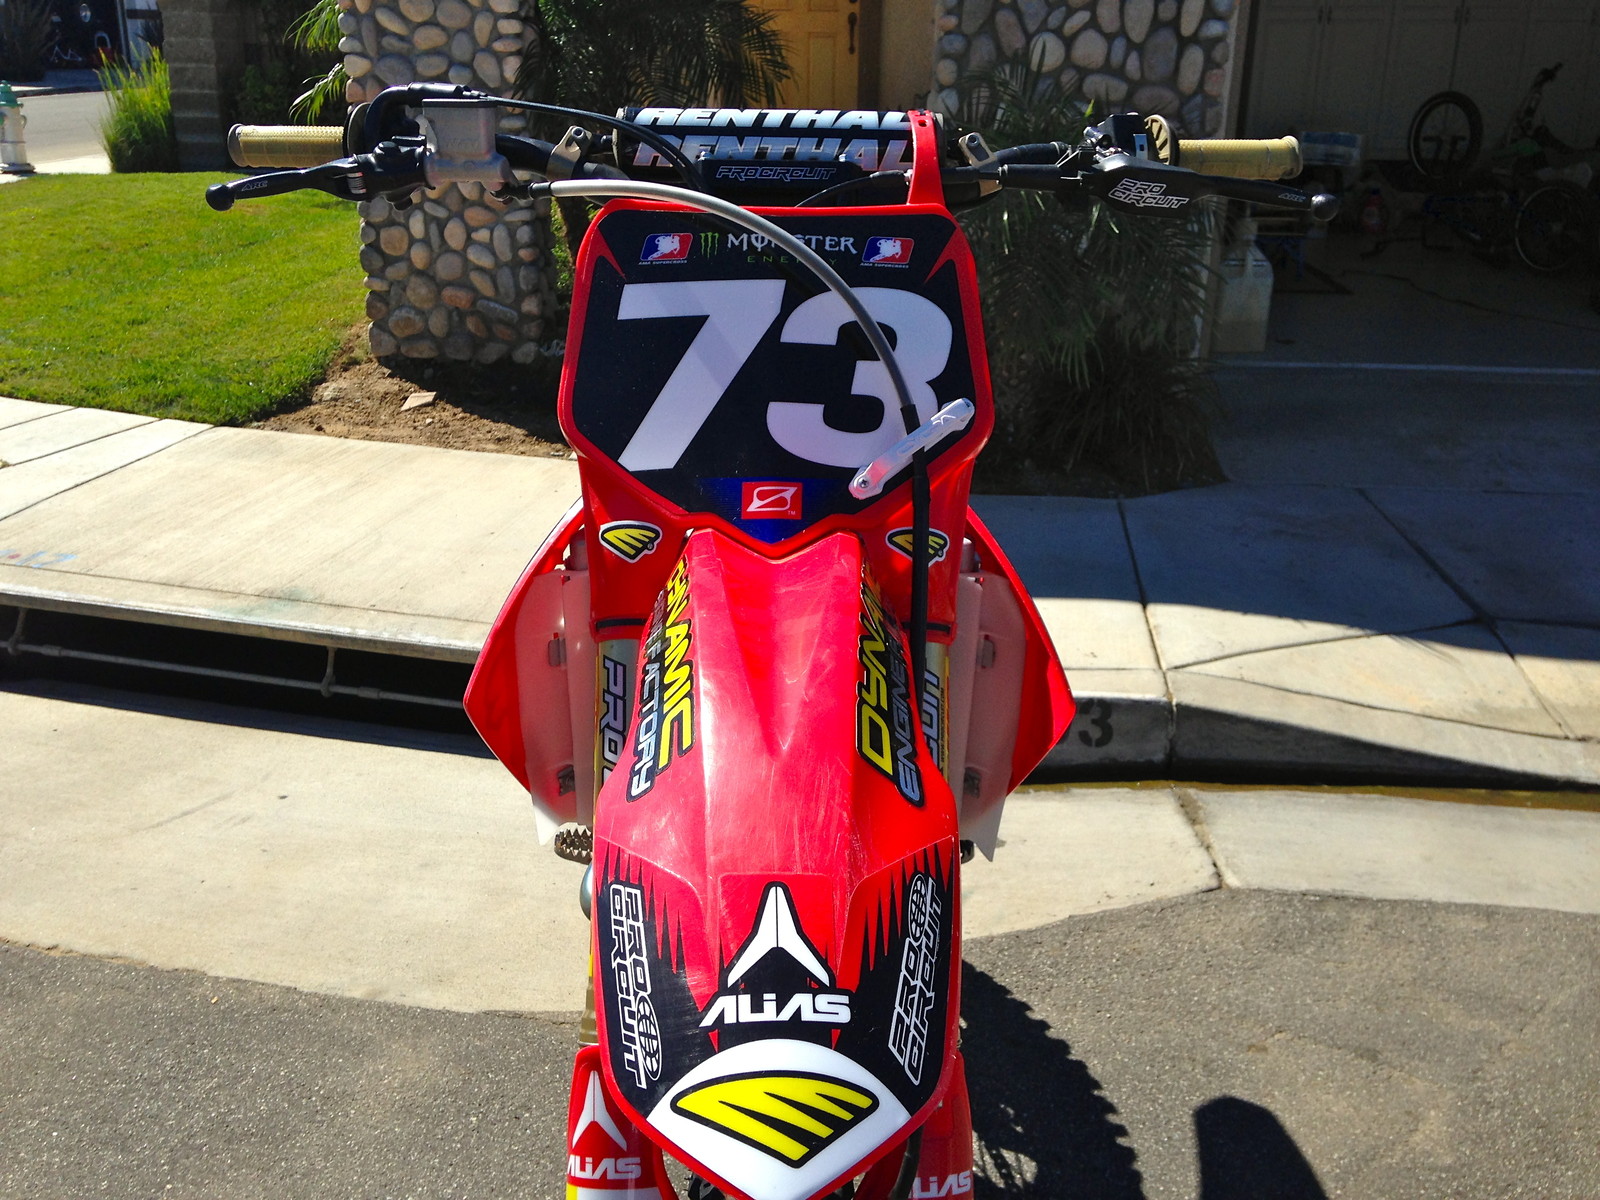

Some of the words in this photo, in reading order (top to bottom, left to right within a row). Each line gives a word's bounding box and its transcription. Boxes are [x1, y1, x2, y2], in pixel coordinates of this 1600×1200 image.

[633, 108, 912, 131] RENTHAL
[1108, 187, 1190, 209] CIRCUIT
[1117, 178, 1167, 195] PRO
[747, 255, 838, 266] ENEY
[617, 279, 953, 472] 73
[860, 568, 893, 776] DYNA
[609, 884, 647, 1090] CIRCUIT
[624, 886, 652, 996] PRO
[904, 877, 942, 1086] CIRCUIT
[888, 937, 921, 1067] PRO
[908, 1170, 971, 1199] LiAS
